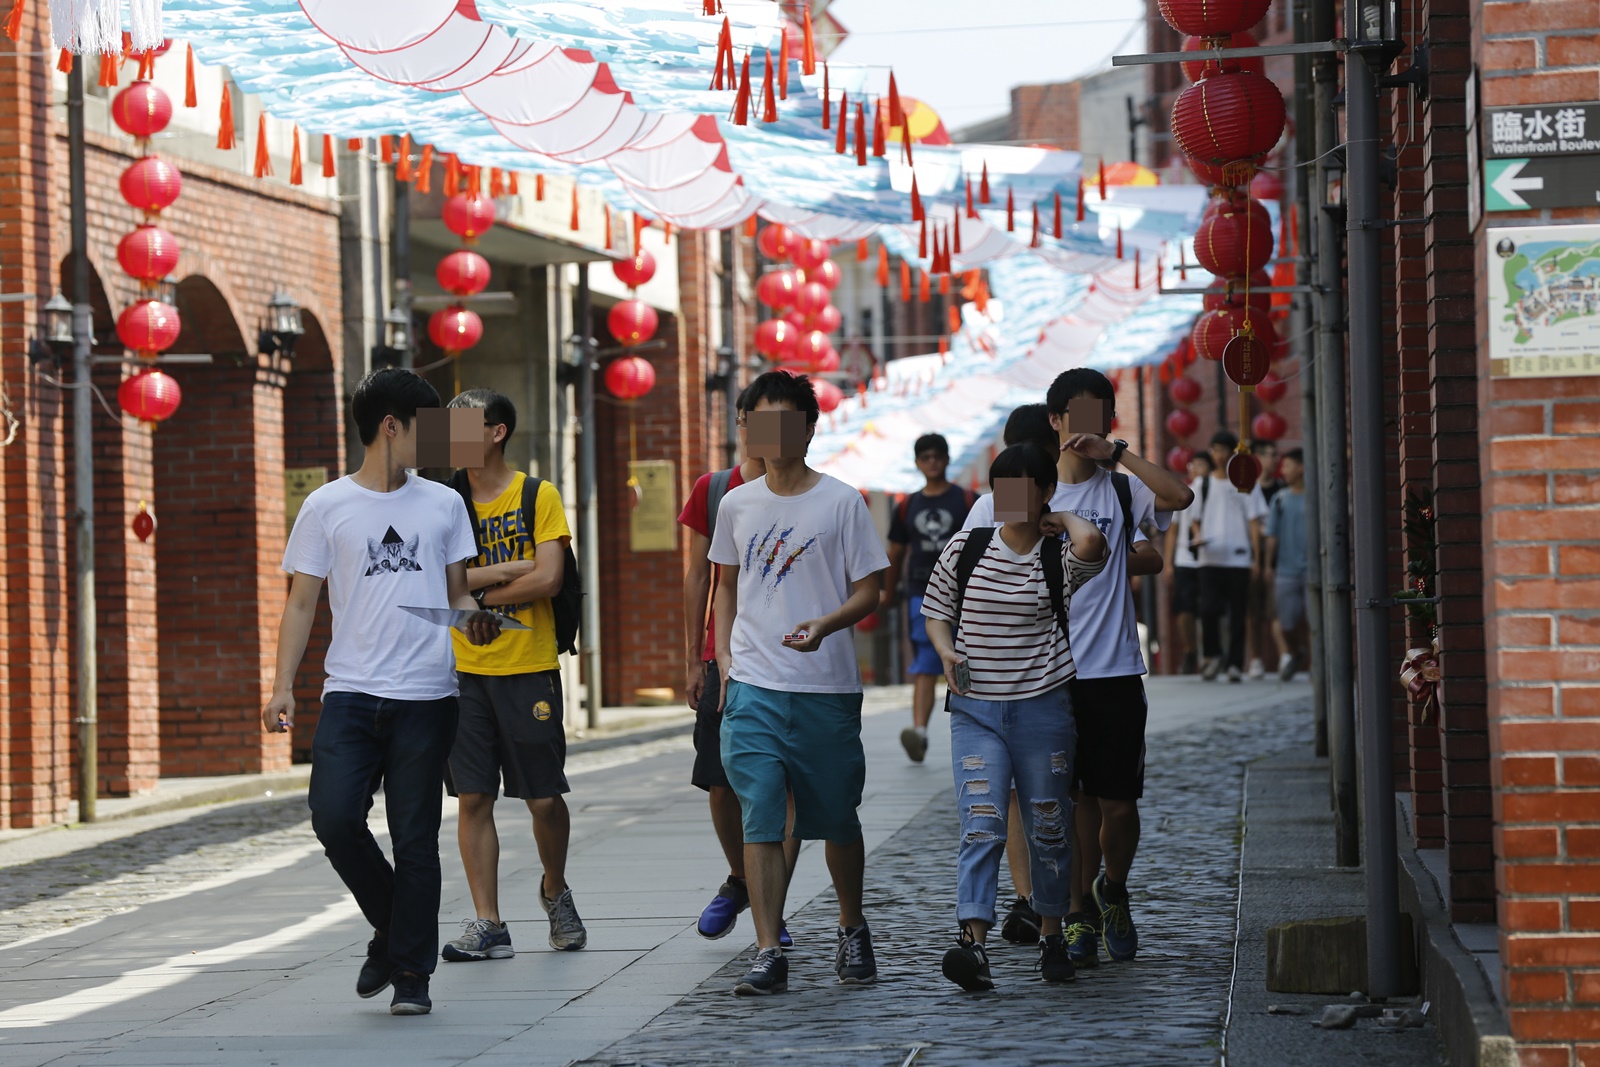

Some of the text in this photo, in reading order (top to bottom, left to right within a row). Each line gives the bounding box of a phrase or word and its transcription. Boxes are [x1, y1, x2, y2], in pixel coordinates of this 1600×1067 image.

[1492, 108, 1586, 142] 臨水街
[1492, 141, 1557, 154] Waterfront
[478, 507, 528, 545] HREE
[468, 536, 530, 568] OINT
